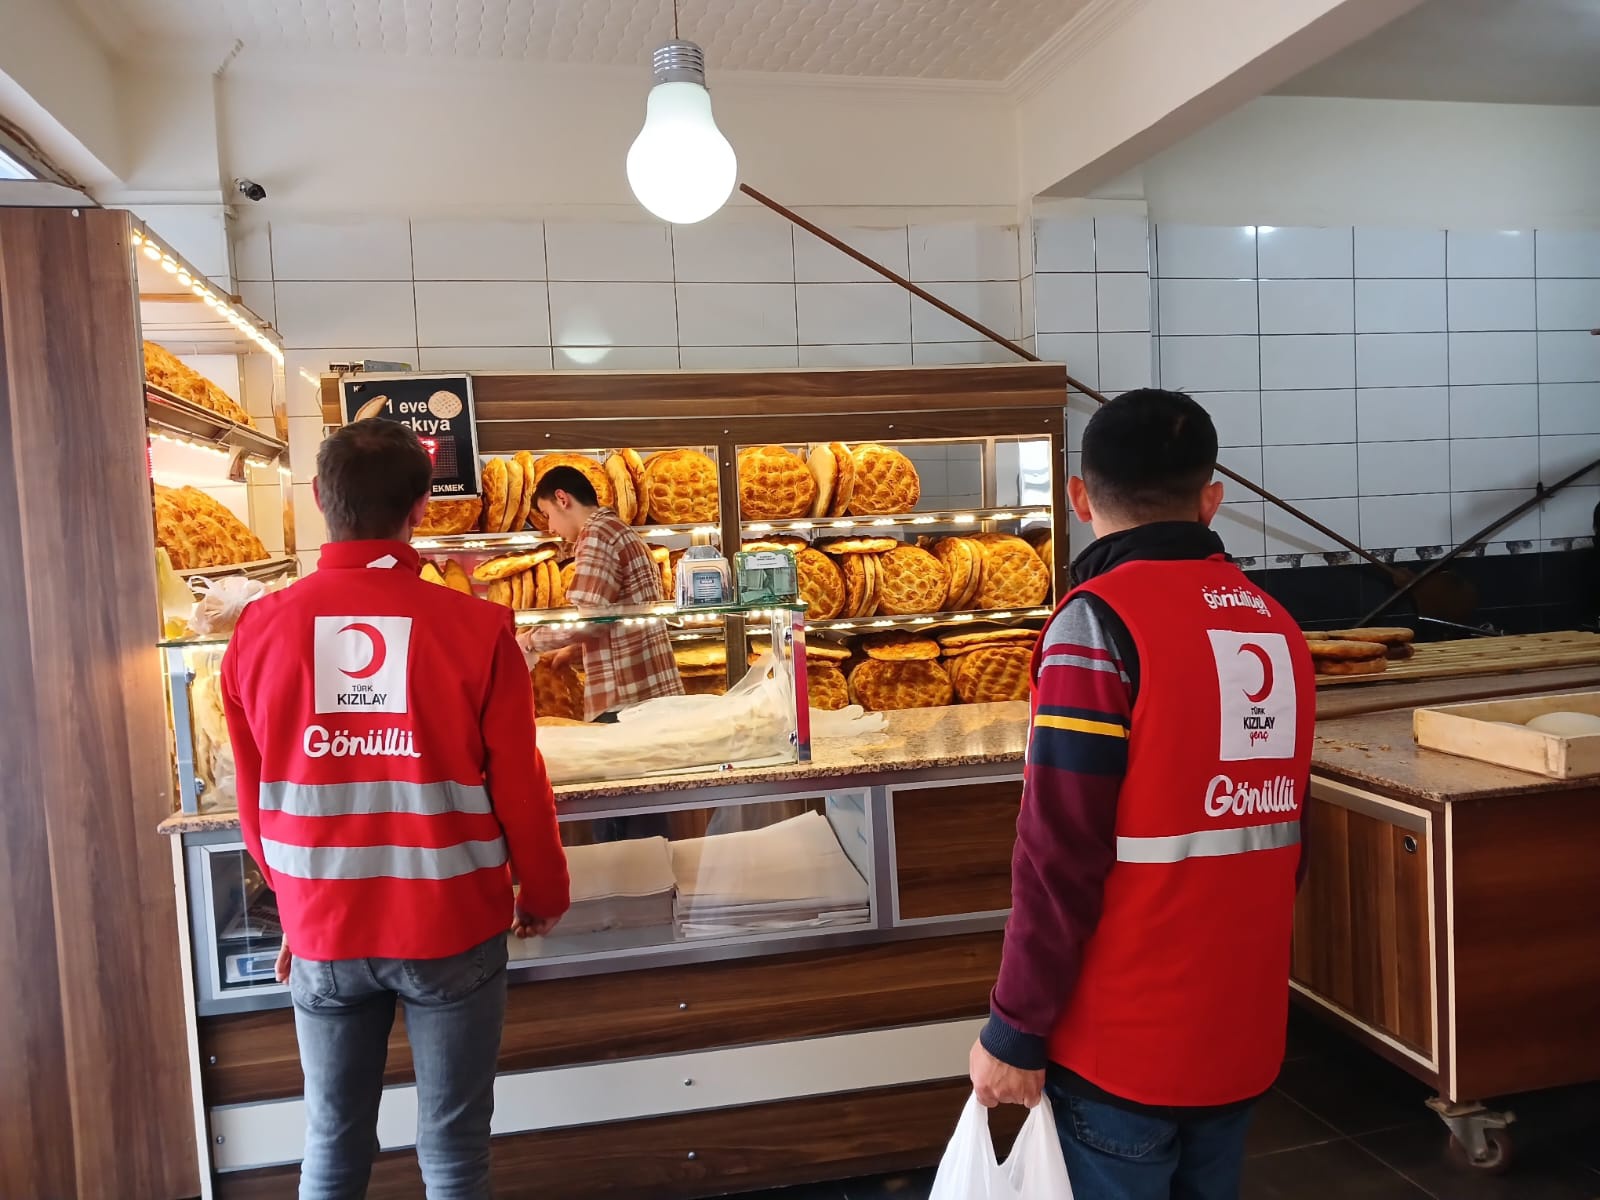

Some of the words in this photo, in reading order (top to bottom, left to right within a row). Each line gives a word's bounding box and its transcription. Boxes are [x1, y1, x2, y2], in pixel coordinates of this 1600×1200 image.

[386, 399, 393, 414] 1
[400, 402, 427, 414] eve
[433, 483, 464, 492] EKMEK
[352, 684, 373, 692] TÜRK
[337, 694, 387, 705] KIZILAY
[1251, 706, 1266, 715] TÜRK
[1243, 717, 1275, 730] KIZILAY
[303, 725, 421, 758] Gönüllü
[1249, 731, 1269, 747] genç
[1205, 774, 1298, 817] Gönüllü
